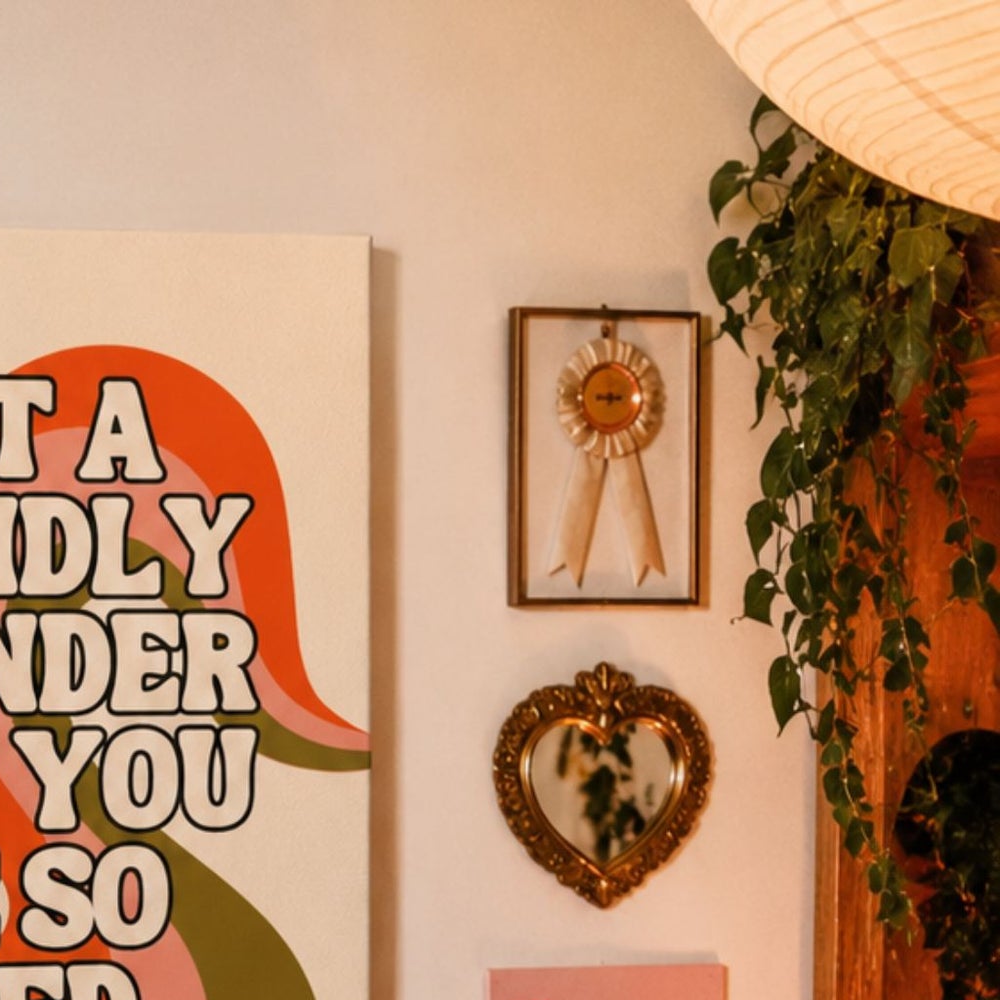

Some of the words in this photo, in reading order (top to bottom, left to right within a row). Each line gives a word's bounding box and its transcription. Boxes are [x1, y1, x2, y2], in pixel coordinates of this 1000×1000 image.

[75, 376, 167, 483] A
[9, 723, 260, 832] YOU
[17, 841, 173, 951] SO
